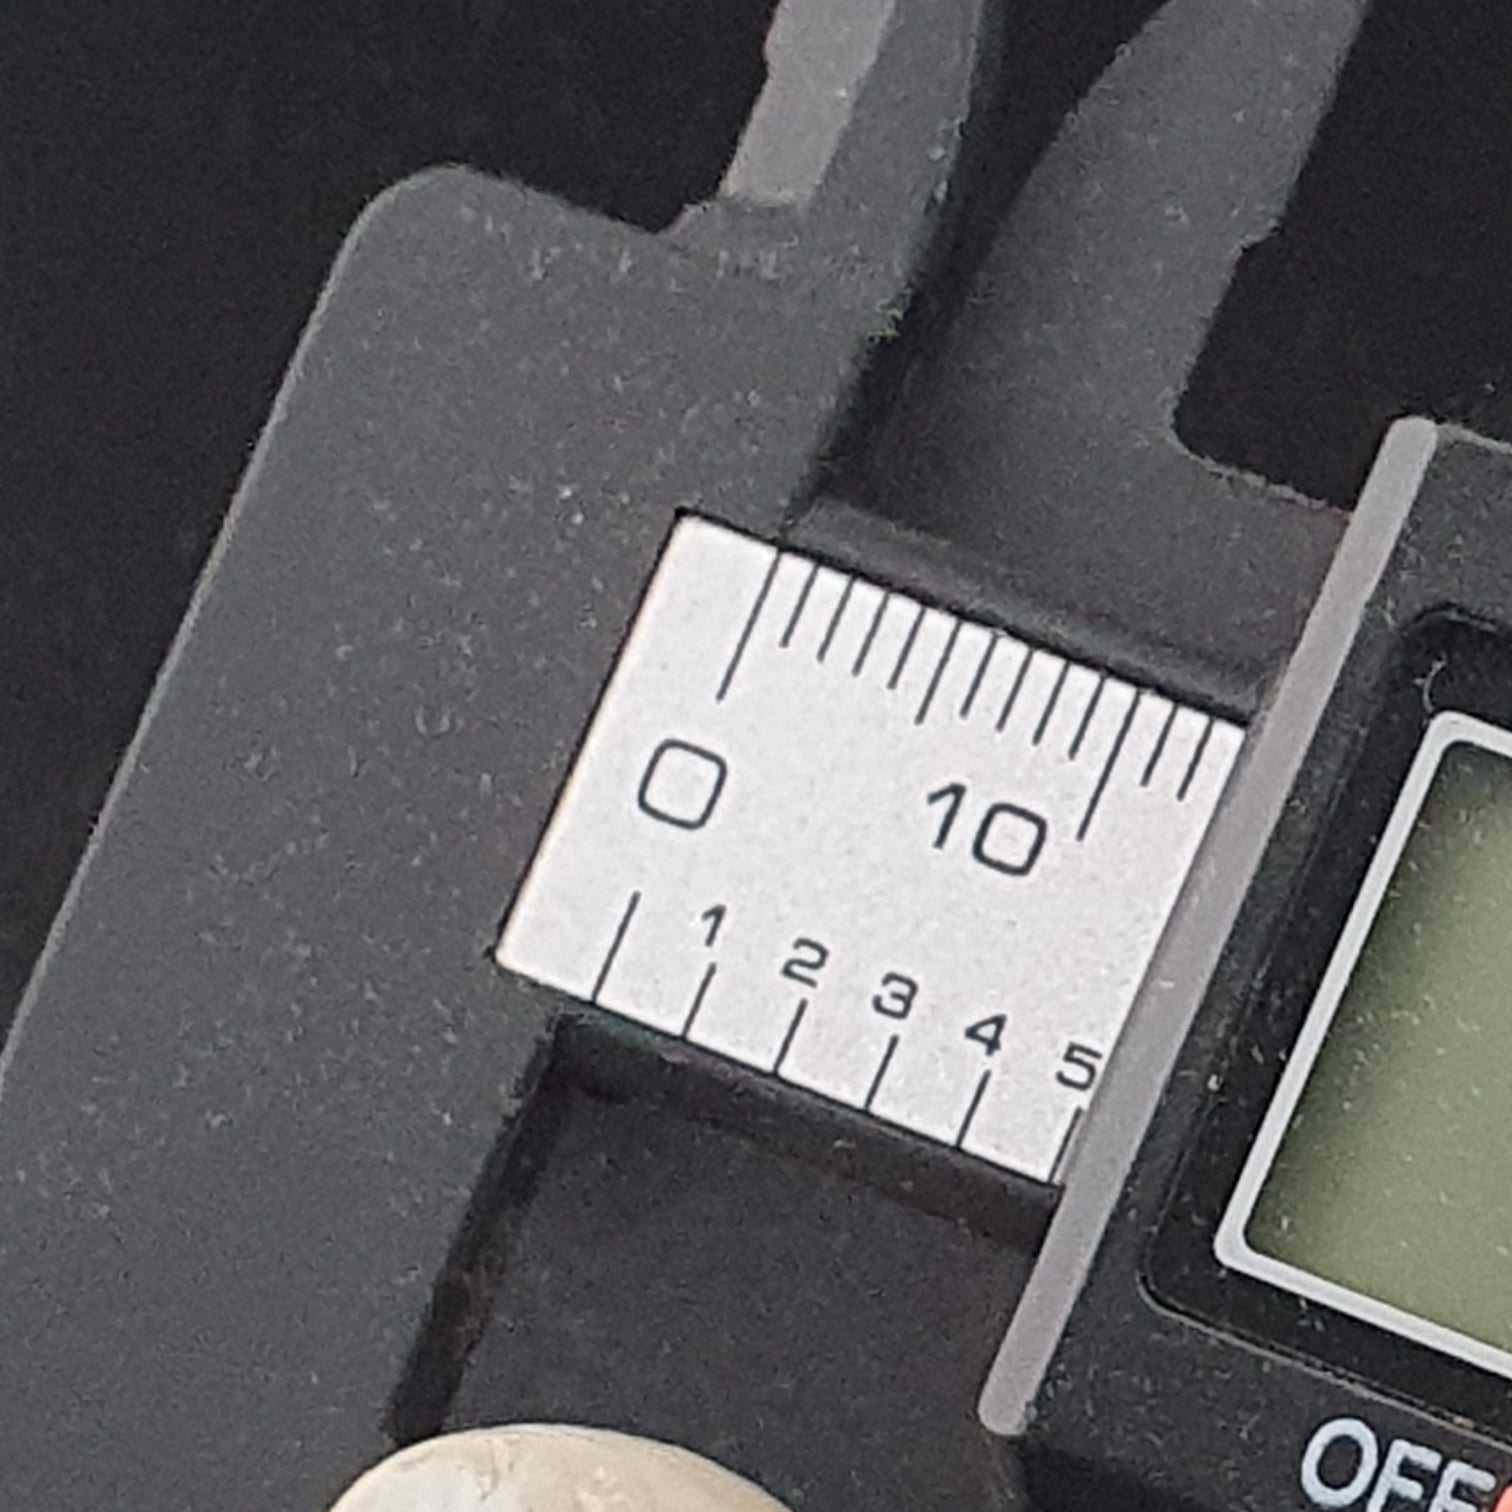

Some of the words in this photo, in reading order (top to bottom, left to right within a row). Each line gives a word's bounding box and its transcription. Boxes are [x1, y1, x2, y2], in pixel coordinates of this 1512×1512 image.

[636, 739, 727, 830] 0
[926, 782, 1048, 876] 10
[700, 903, 728, 948] 1
[781, 937, 829, 988] 2
[872, 971, 919, 1020] 3
[964, 1013, 1008, 1057] 4
[1054, 1041, 1103, 1092] 5
